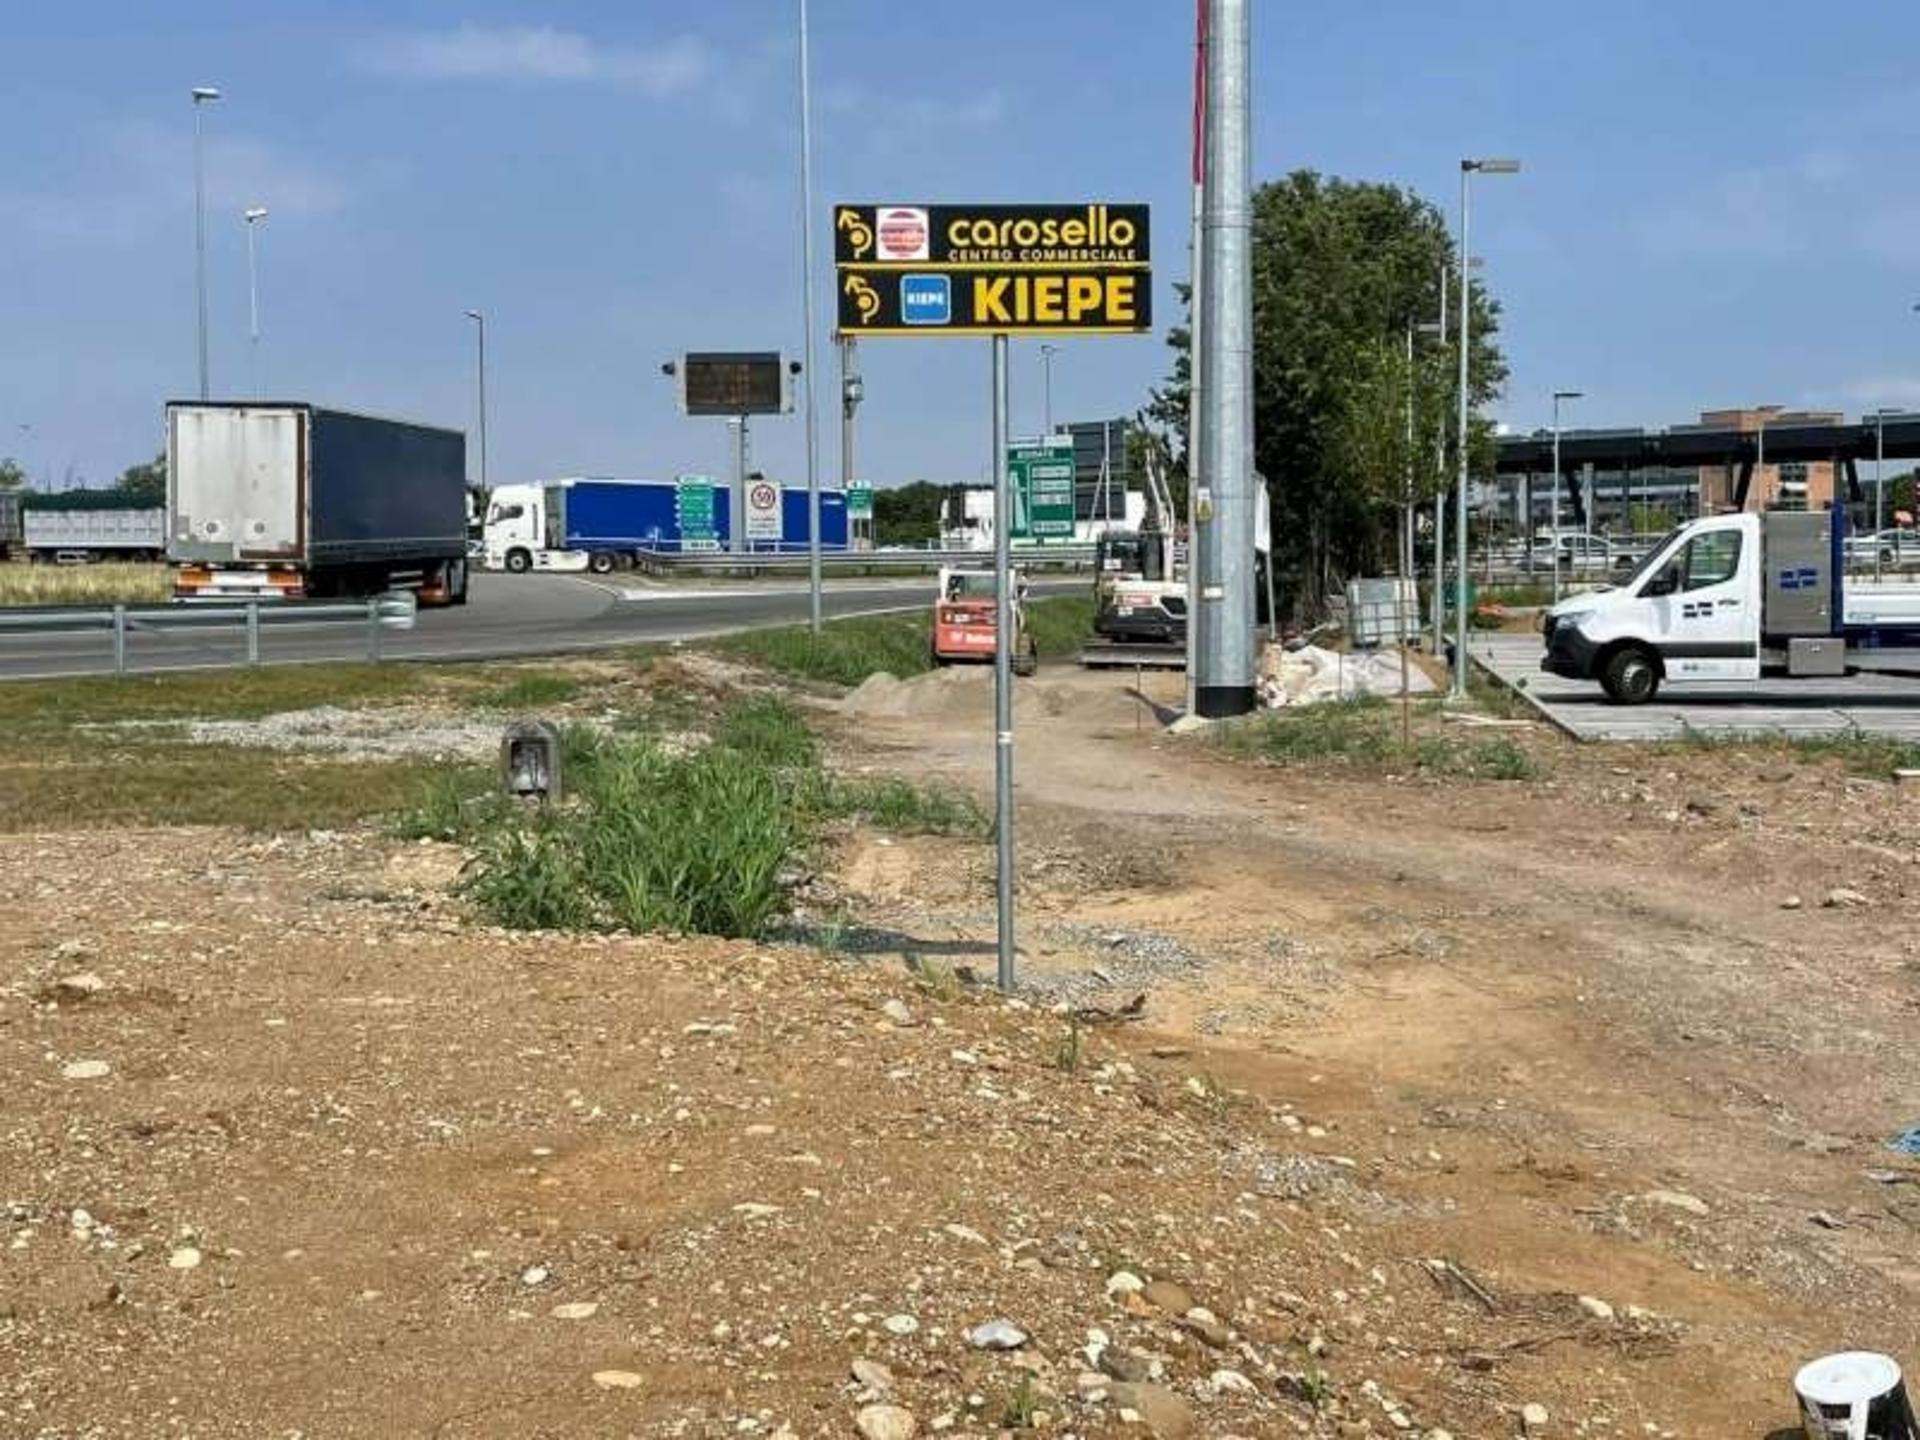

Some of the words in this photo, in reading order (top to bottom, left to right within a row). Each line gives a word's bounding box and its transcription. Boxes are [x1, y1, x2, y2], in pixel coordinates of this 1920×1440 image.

[948, 205, 1134, 247] carosello
[948, 249, 1013, 262] CENTRO
[1020, 249, 1136, 262] COMMERCIALE
[906, 292, 944, 305] KIEPE
[974, 276, 1136, 322] KIEPE
